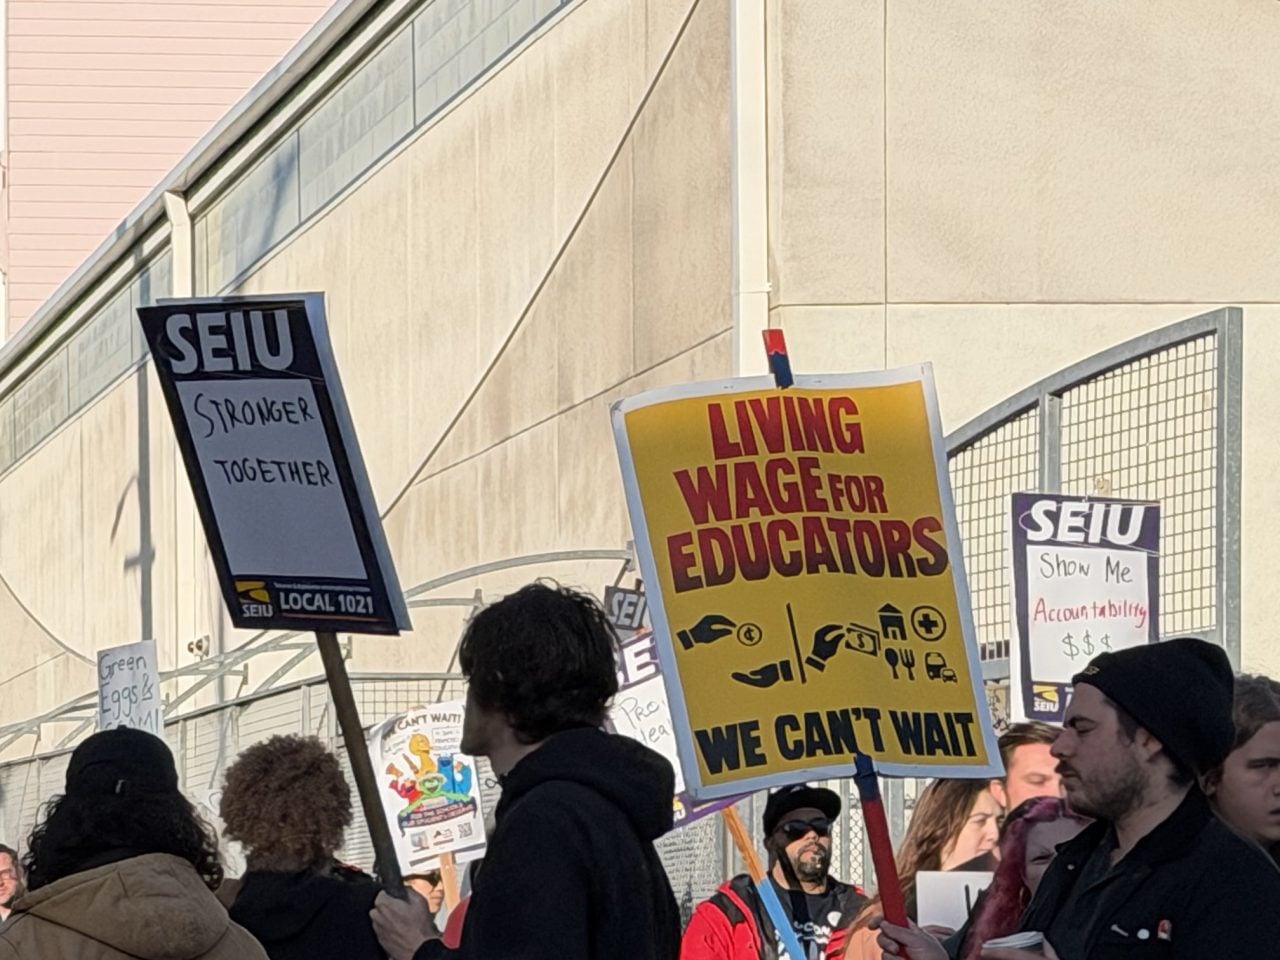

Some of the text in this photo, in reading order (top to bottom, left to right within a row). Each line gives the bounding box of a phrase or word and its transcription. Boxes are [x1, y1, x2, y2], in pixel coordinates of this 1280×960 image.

[164, 308, 295, 374] SEIU
[193, 392, 316, 439] STRONGER
[707, 396, 865, 460] LIVING
[213, 458, 335, 488] TOGETHER
[673, 456, 889, 525] WAGE FOR
[1027, 500, 1146, 545] SEIU
[666, 515, 950, 594] EDUCATORS
[1039, 552, 1134, 584] Show Me
[241, 603, 273, 618] SEIU
[279, 591, 374, 615] LOCAL 1021
[610, 591, 646, 628] SEI
[100, 653, 147, 681] Green
[101, 682, 138, 720] Eggs
[1033, 701, 1059, 713] SEIU
[397, 714, 429, 731] CAN'T
[694, 708, 978, 775] WE CAN'T WAIT
